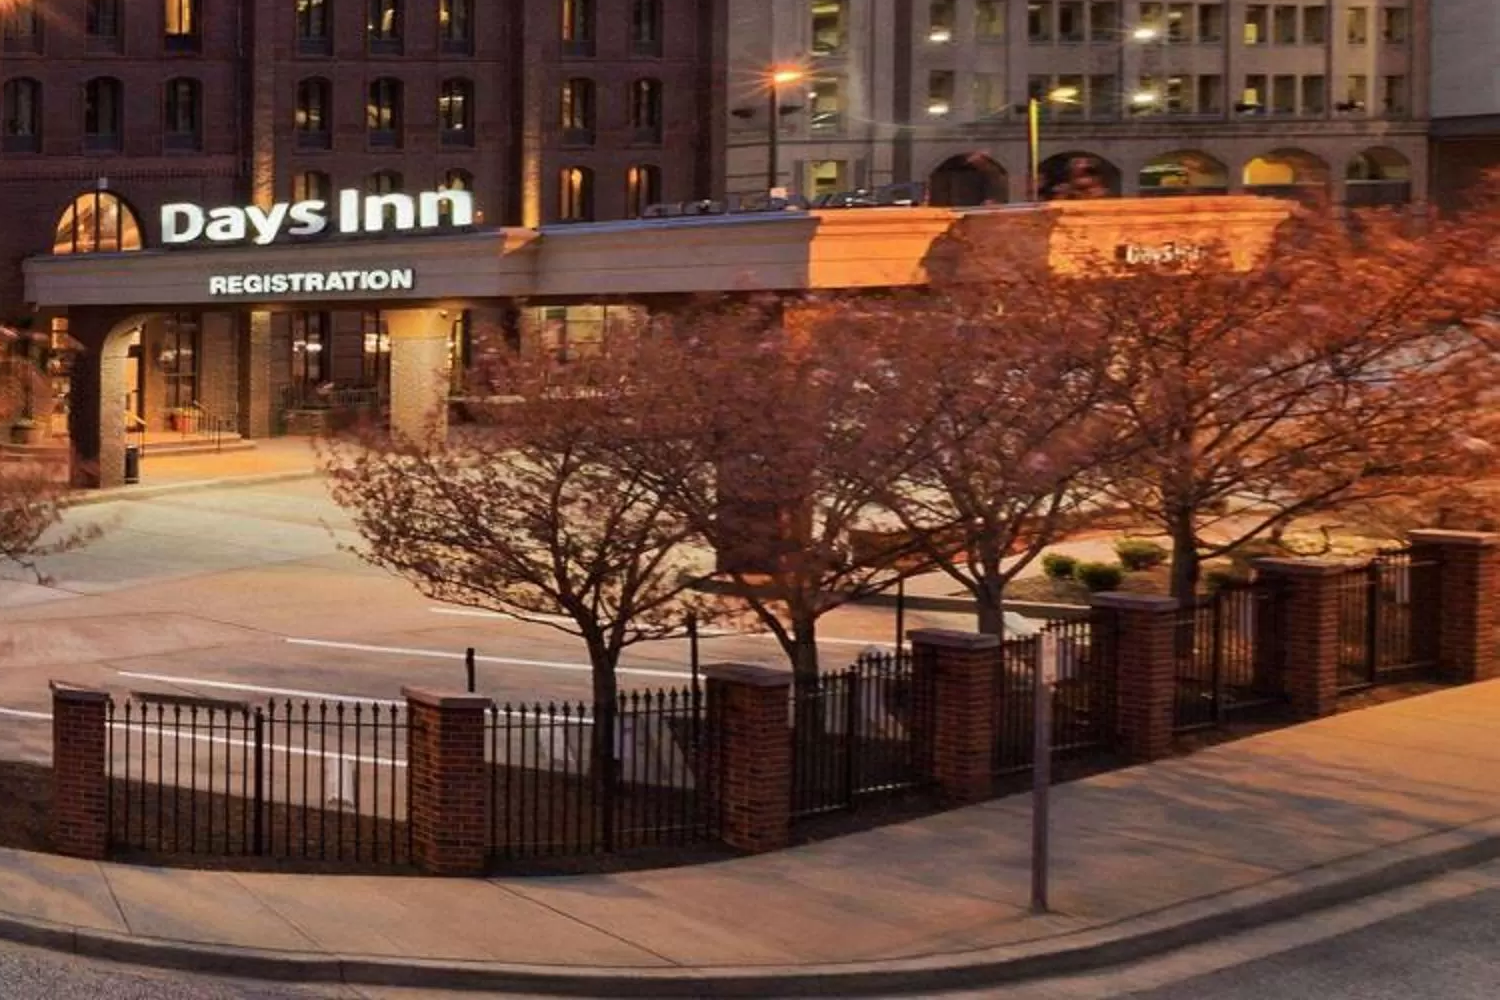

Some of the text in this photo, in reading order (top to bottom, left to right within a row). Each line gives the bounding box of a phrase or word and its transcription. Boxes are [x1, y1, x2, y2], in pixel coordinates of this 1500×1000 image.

[160, 188, 474, 245] Days Inn
[209, 268, 414, 295] REGISTRATION
